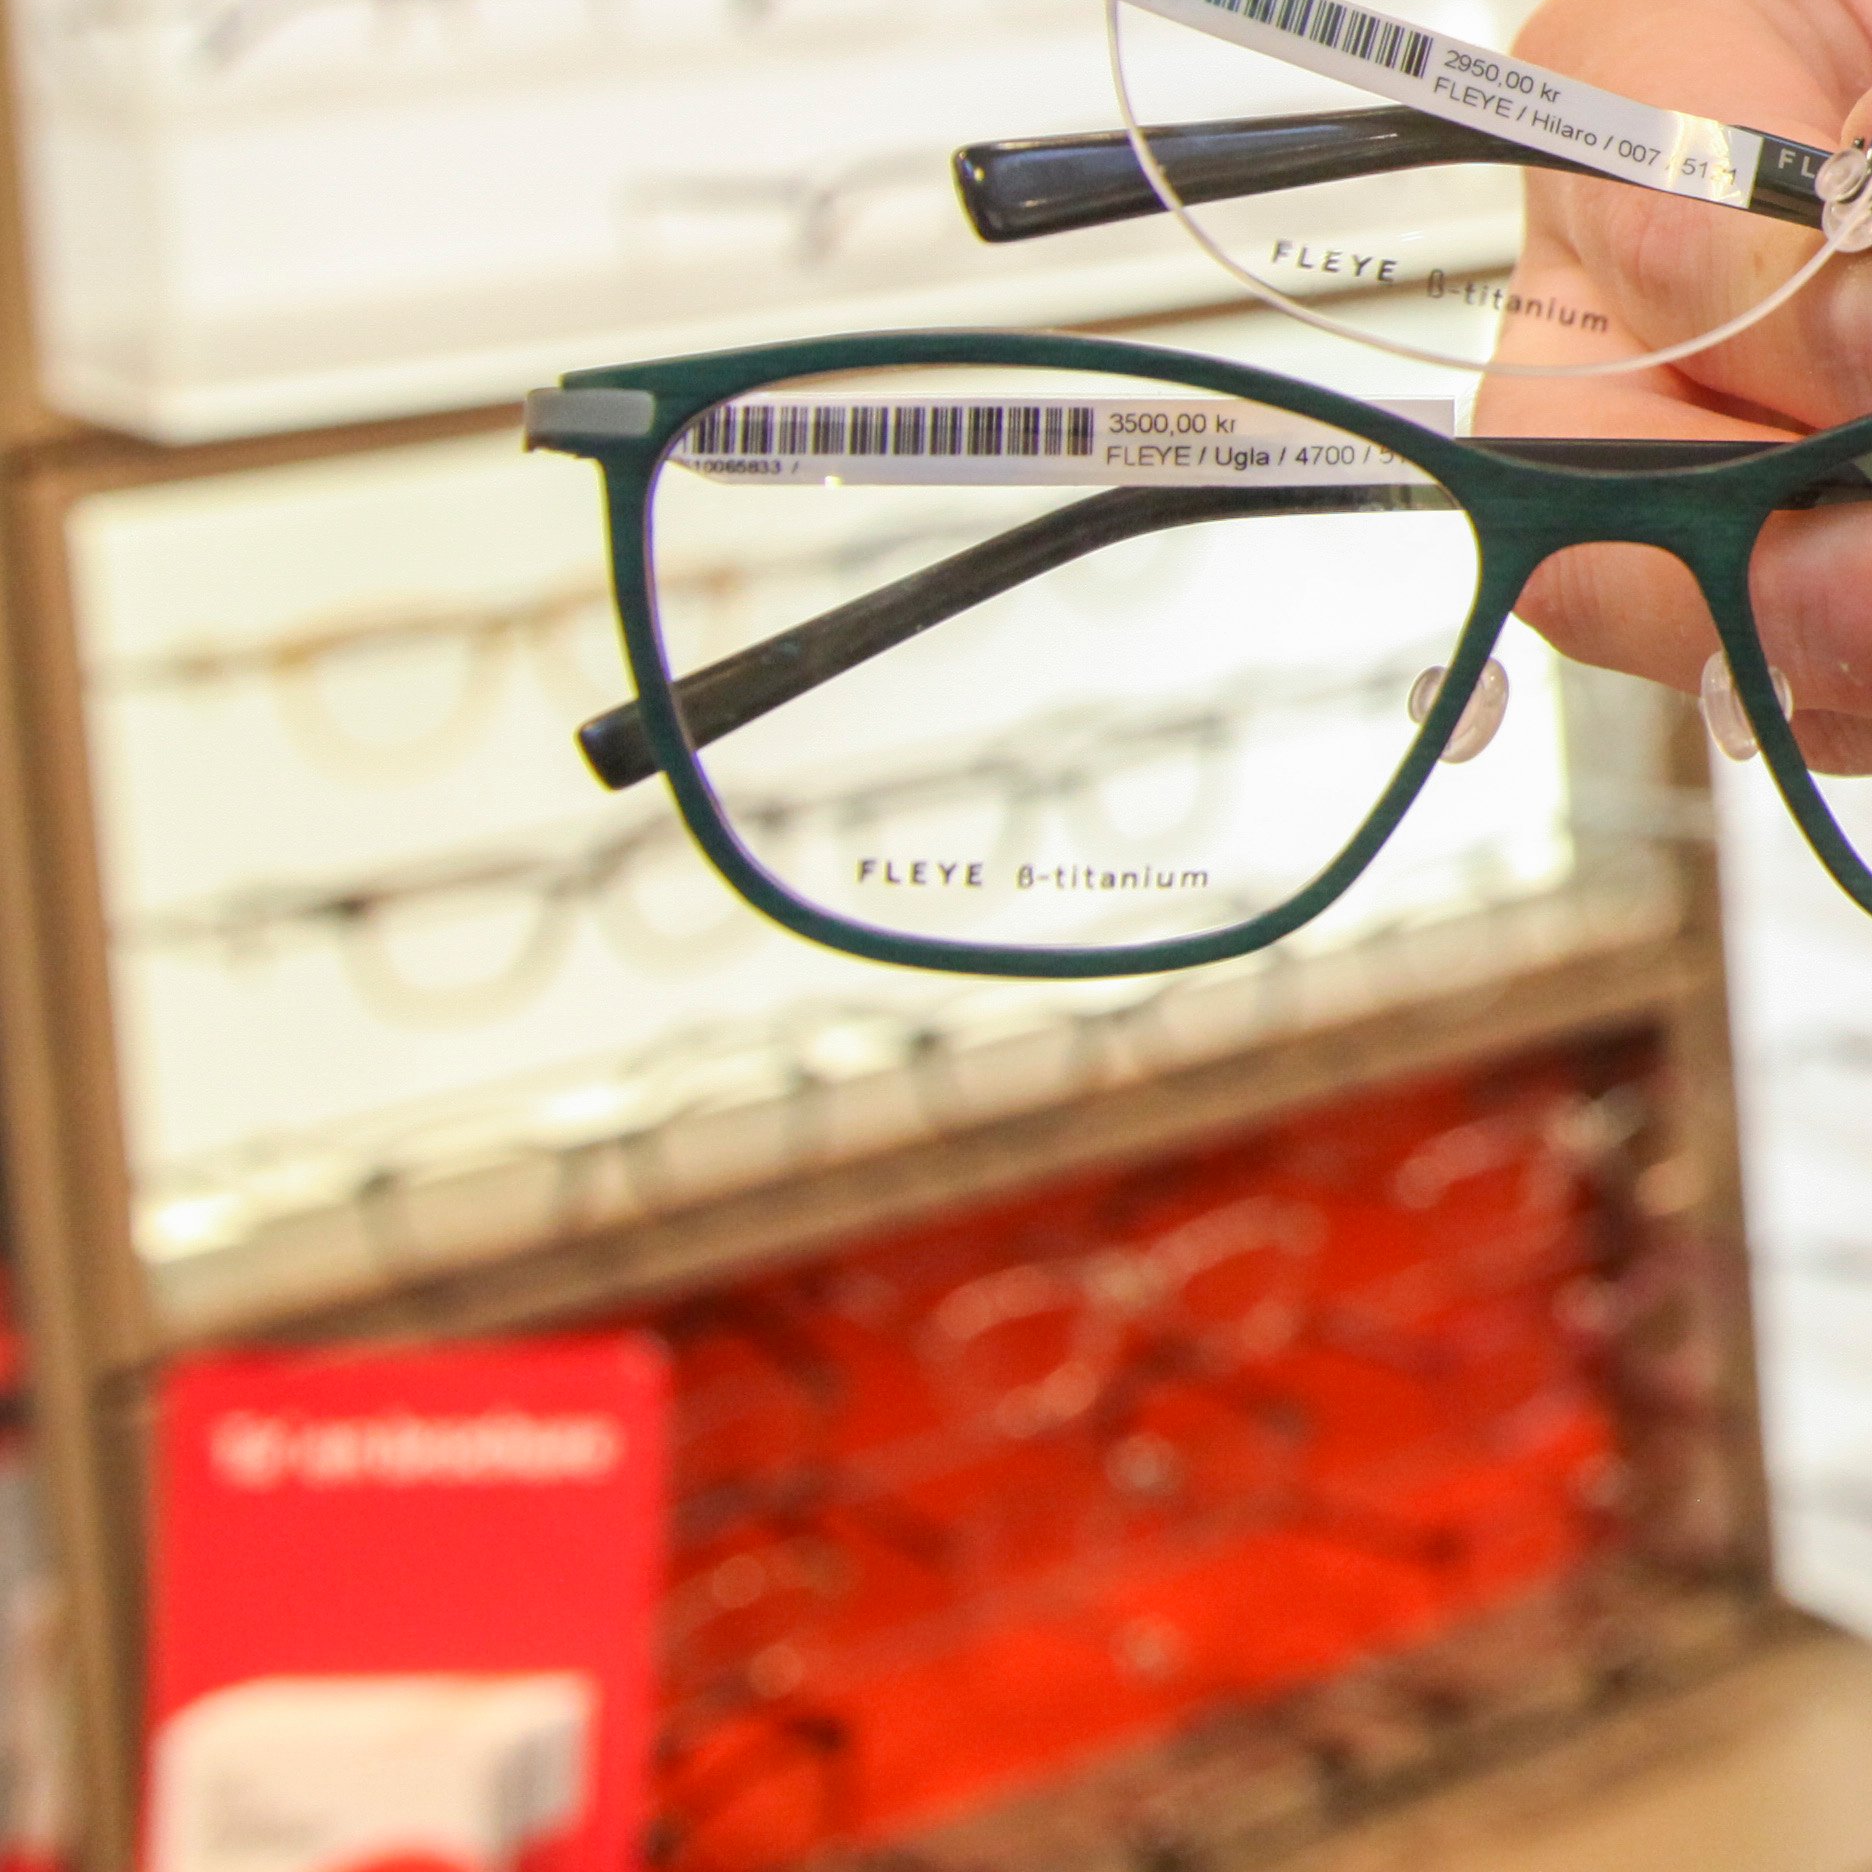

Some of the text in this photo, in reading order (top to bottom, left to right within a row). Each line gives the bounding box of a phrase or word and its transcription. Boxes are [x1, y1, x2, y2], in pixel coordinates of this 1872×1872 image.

[1444, 49, 1561, 104] 2950,00 kr
[1433, 76, 1514, 120] FLEYE
[1531, 111, 1598, 147] Hilaro
[1618, 139, 1662, 167] 007
[1271, 238, 1399, 287] FLEYE
[1108, 413, 1236, 437] 3500,00 kr
[1106, 445, 1192, 466] FLEYE
[1214, 446, 1271, 471] Ugla
[1295, 445, 1356, 466] 4700
[857, 858, 985, 888] FLEYE
